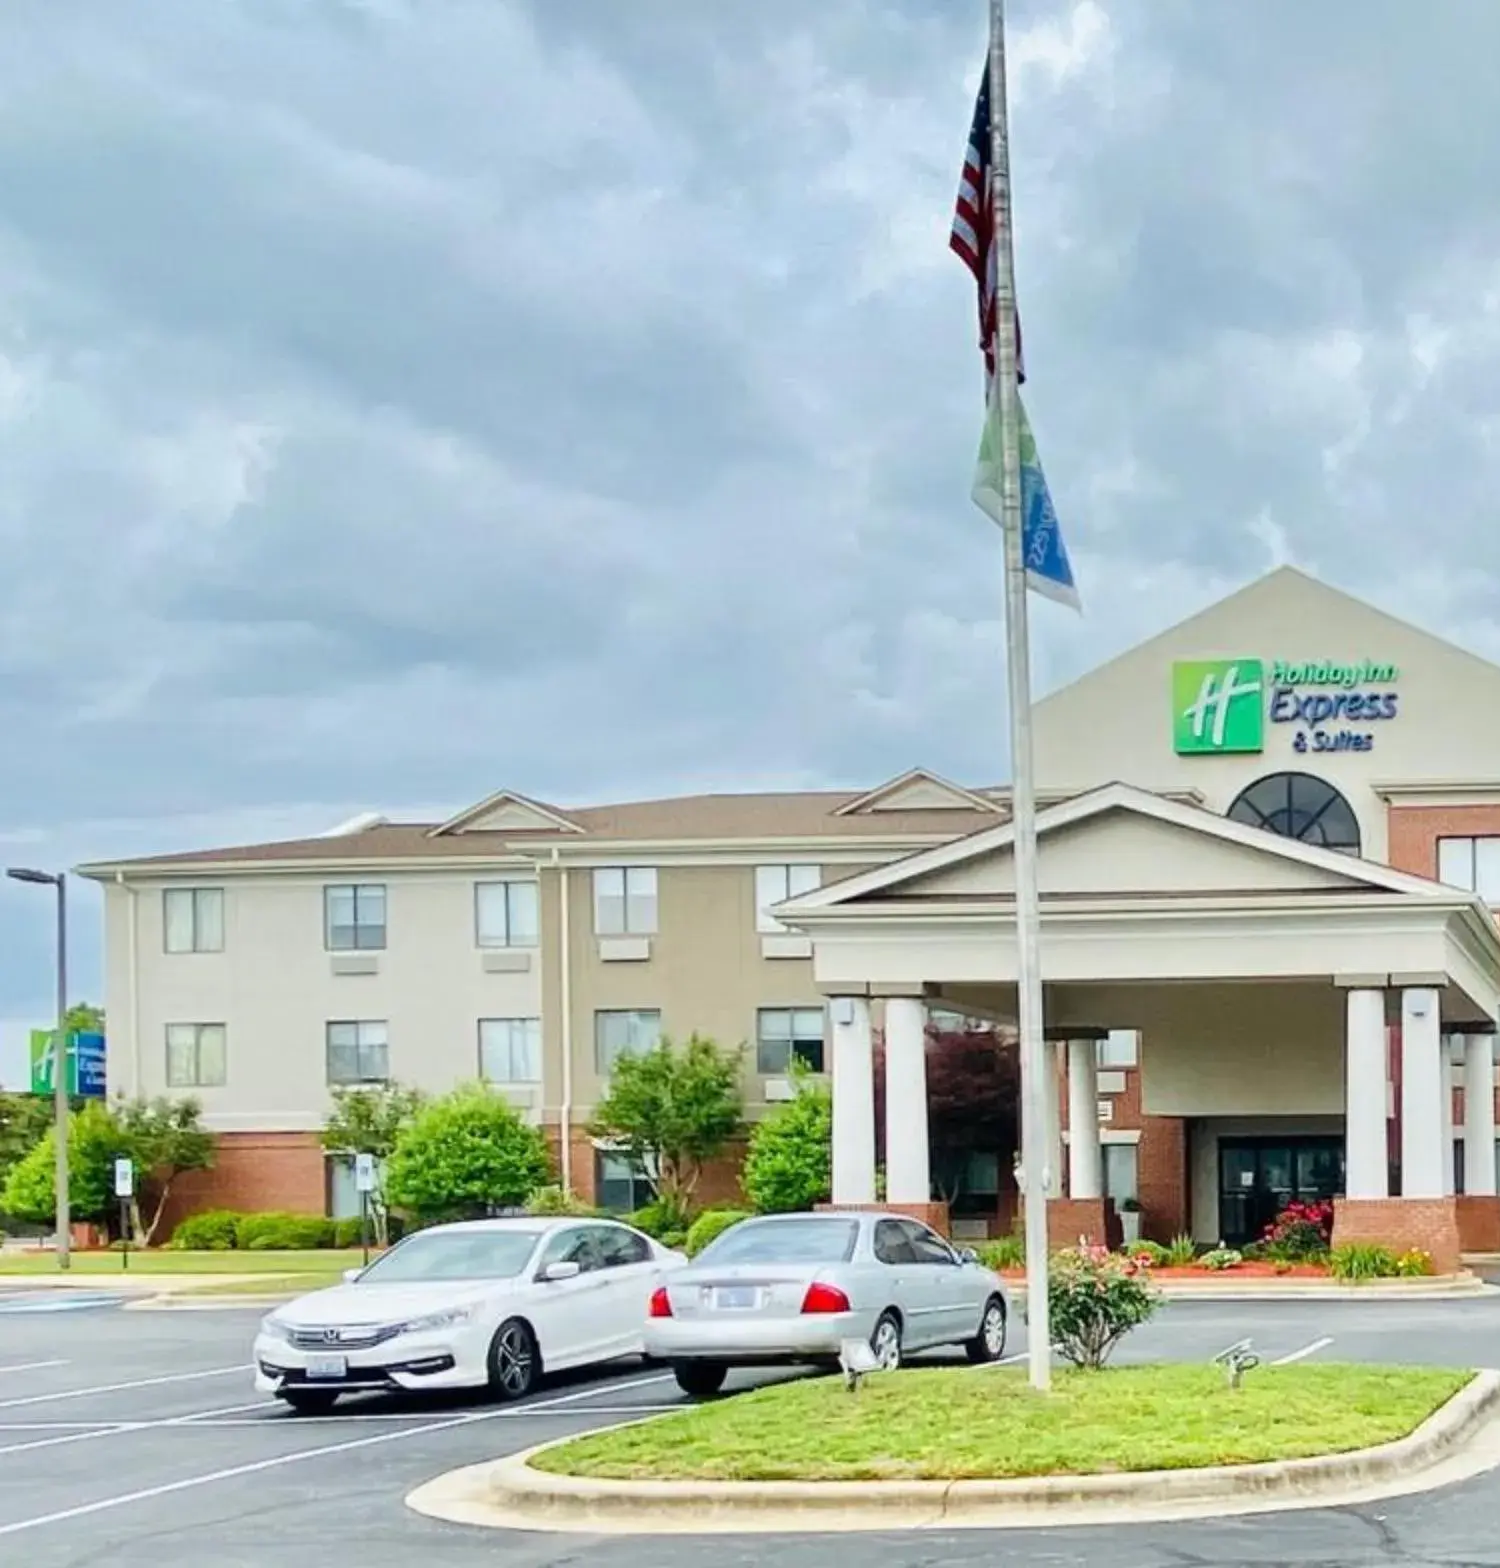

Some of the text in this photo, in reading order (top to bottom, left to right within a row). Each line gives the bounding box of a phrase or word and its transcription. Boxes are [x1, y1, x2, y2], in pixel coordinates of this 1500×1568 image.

[1270, 661, 1397, 689] Holiday Inn
[1183, 667, 1260, 745] H
[1270, 687, 1398, 729] Express
[1293, 730, 1374, 753] & Suites
